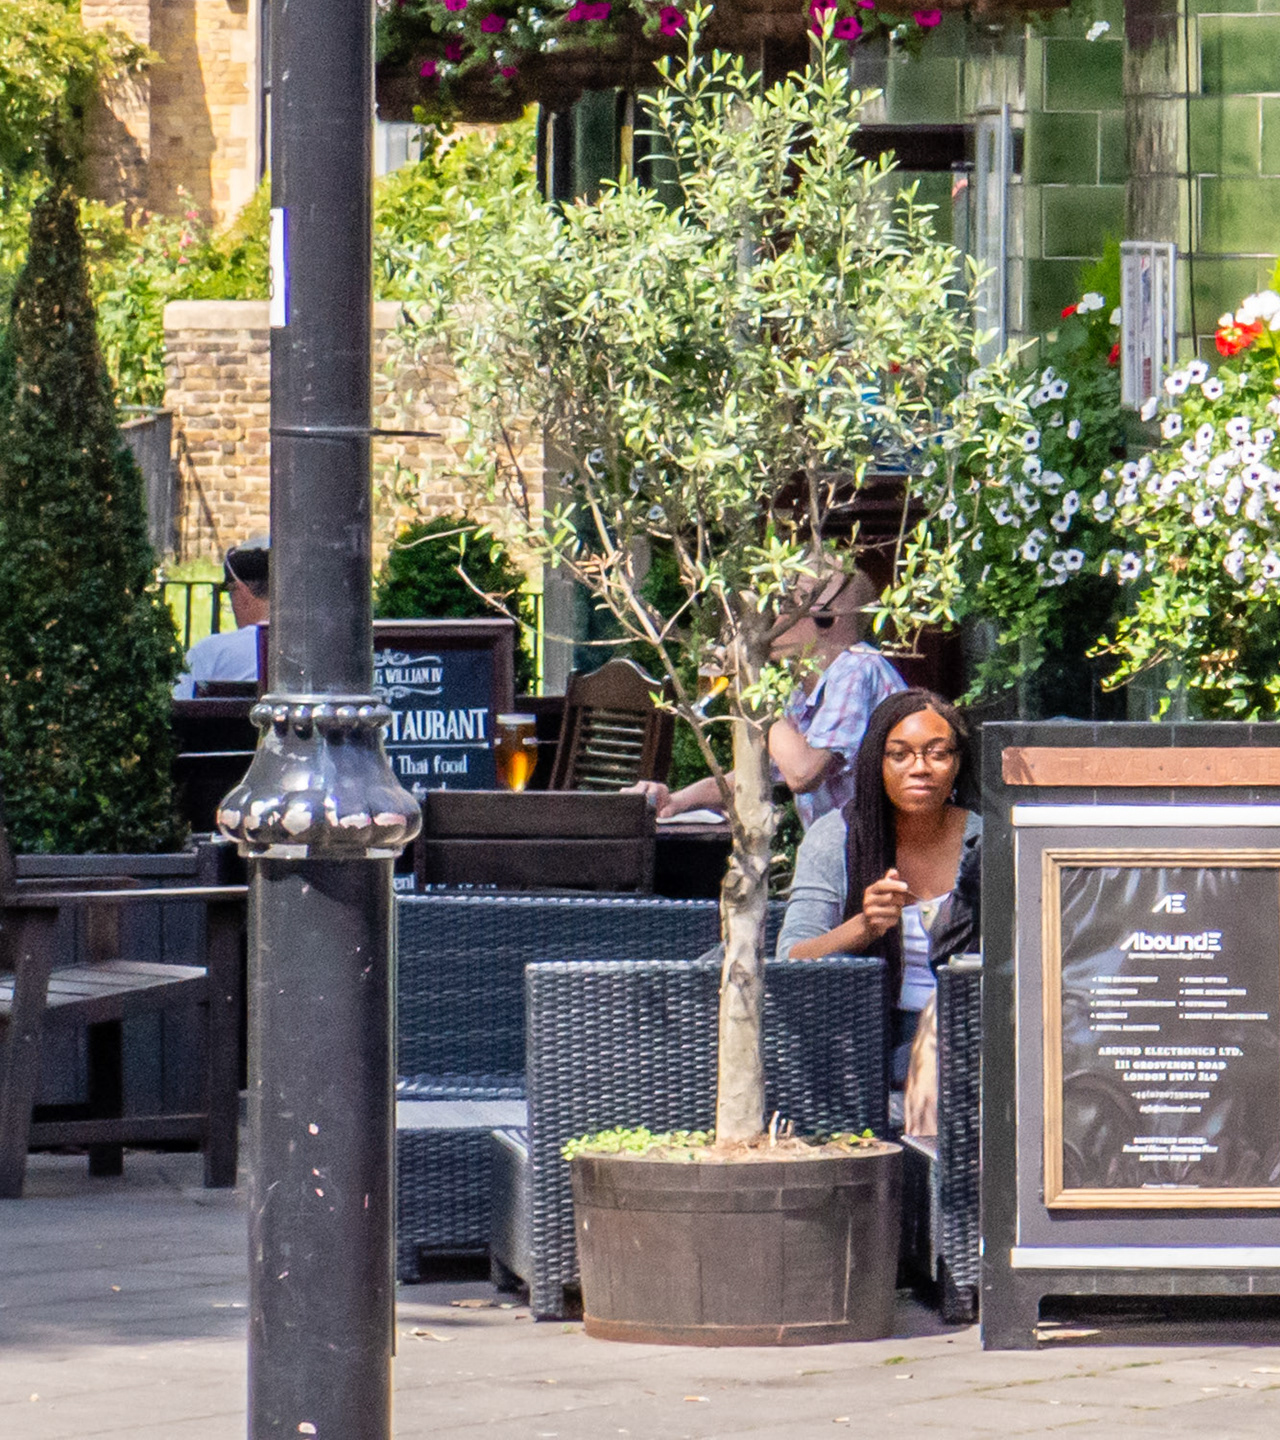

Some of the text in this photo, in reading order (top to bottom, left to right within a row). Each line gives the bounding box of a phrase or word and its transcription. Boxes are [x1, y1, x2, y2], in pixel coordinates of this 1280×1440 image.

[381, 708, 489, 741] TAURANT
[397, 754, 429, 775] Thai
[434, 753, 468, 774] food
[1144, 1046, 1216, 1057] ELECTRONICS
[1132, 1060, 1195, 1070] GROSVENOR
[1197, 1060, 1227, 1071] ROAD
[1122, 1072, 1167, 1082] LONDON
